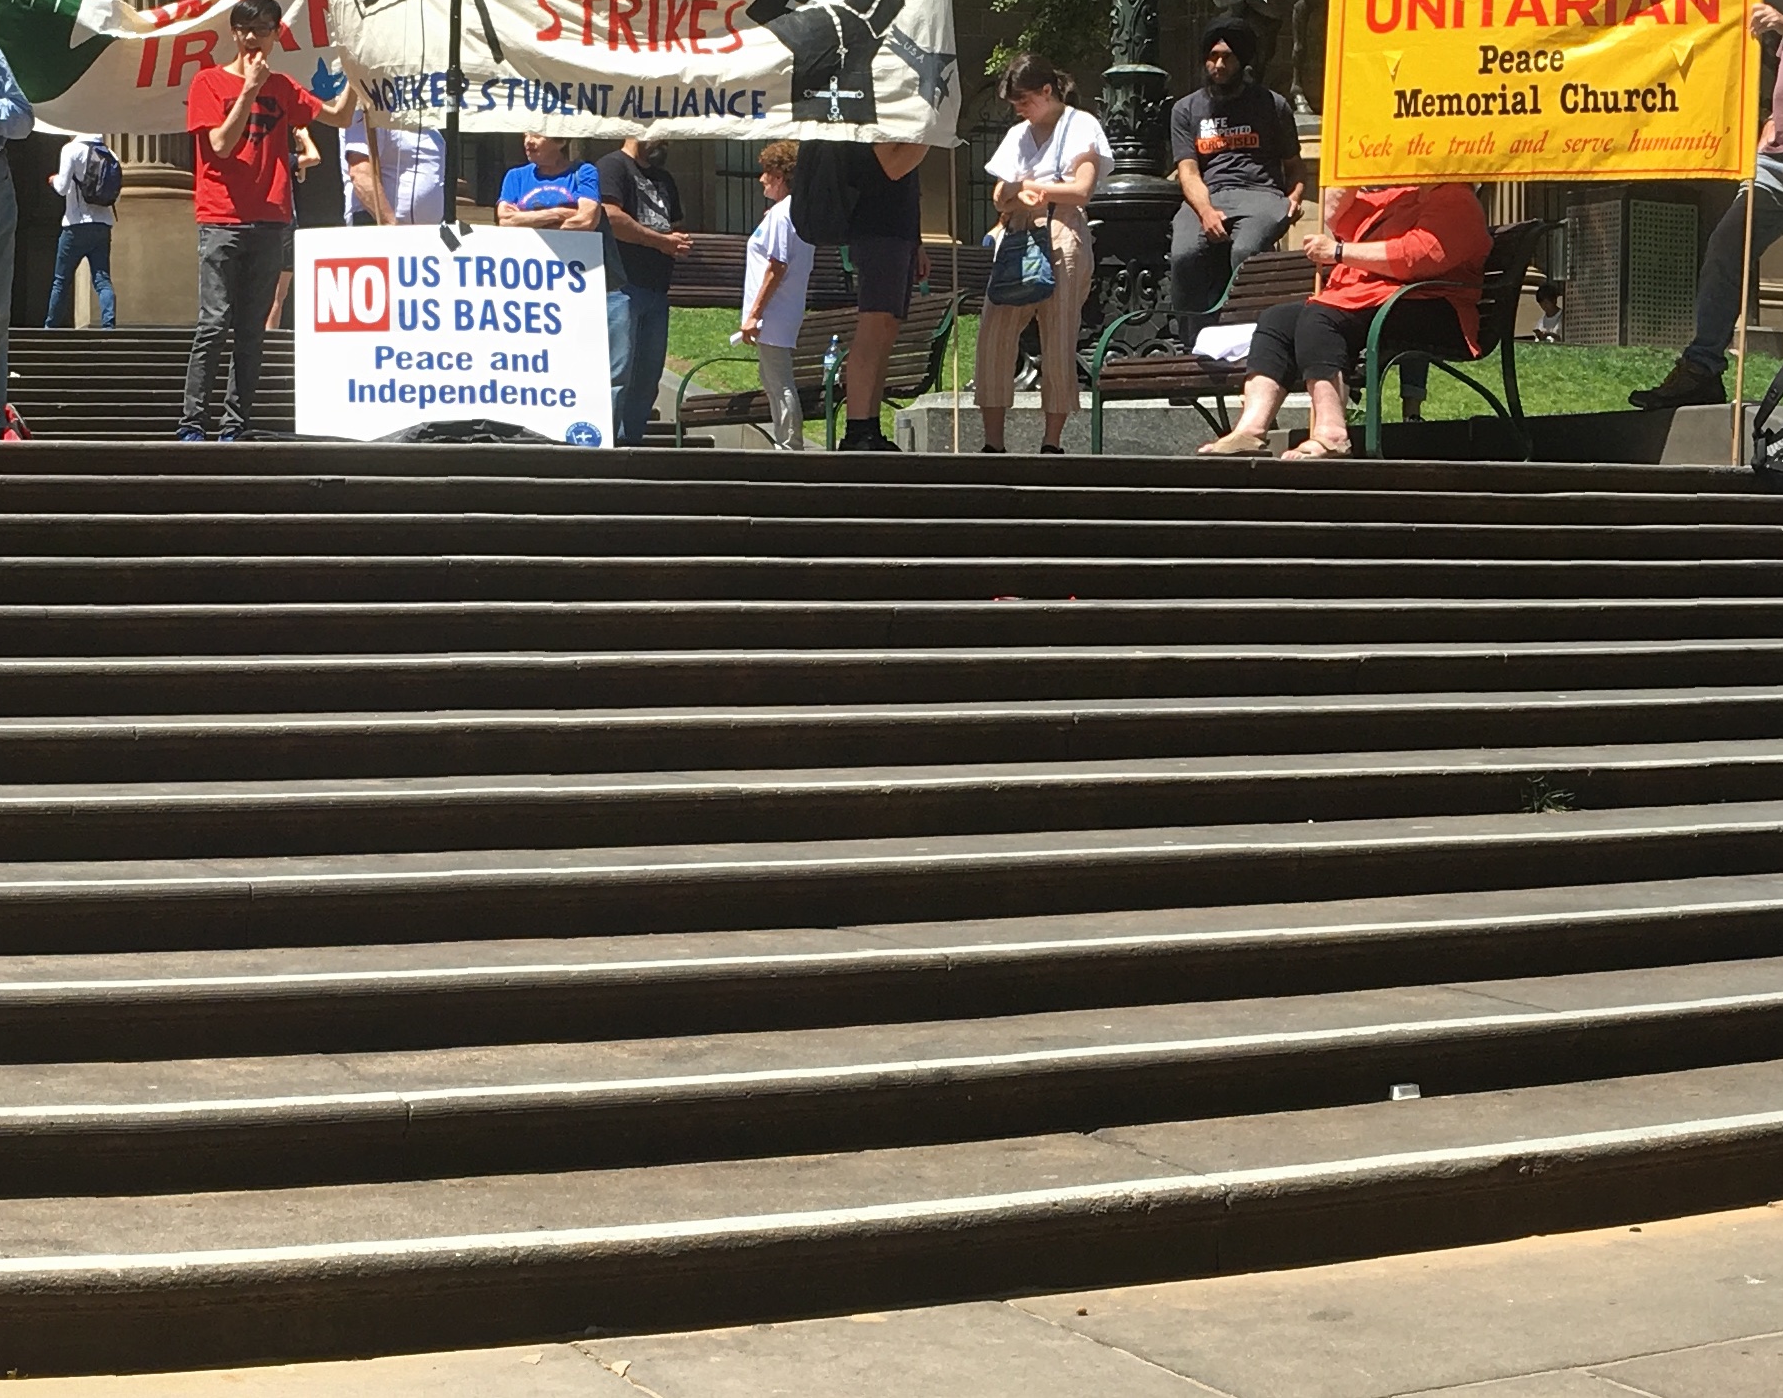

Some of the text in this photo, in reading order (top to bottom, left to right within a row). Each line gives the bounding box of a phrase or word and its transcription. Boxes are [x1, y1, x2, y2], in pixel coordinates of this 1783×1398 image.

[1478, 44, 1565, 75] Peace
[480, 78, 615, 116] STUDENT
[617, 85, 767, 120] ALLIANCE
[1393, 82, 1679, 119] Memorial Church
[1200, 117, 1228, 130] SAFE
[1407, 133, 1435, 156] the
[1448, 130, 1496, 156] truth
[1509, 130, 1549, 155] and
[1562, 135, 1614, 154] serve
[398, 255, 587, 293] US TROOPS
[315, 265, 387, 324] NO
[398, 298, 563, 336] US BASES
[374, 345, 549, 374] Peace and
[348, 378, 577, 409] Independence
